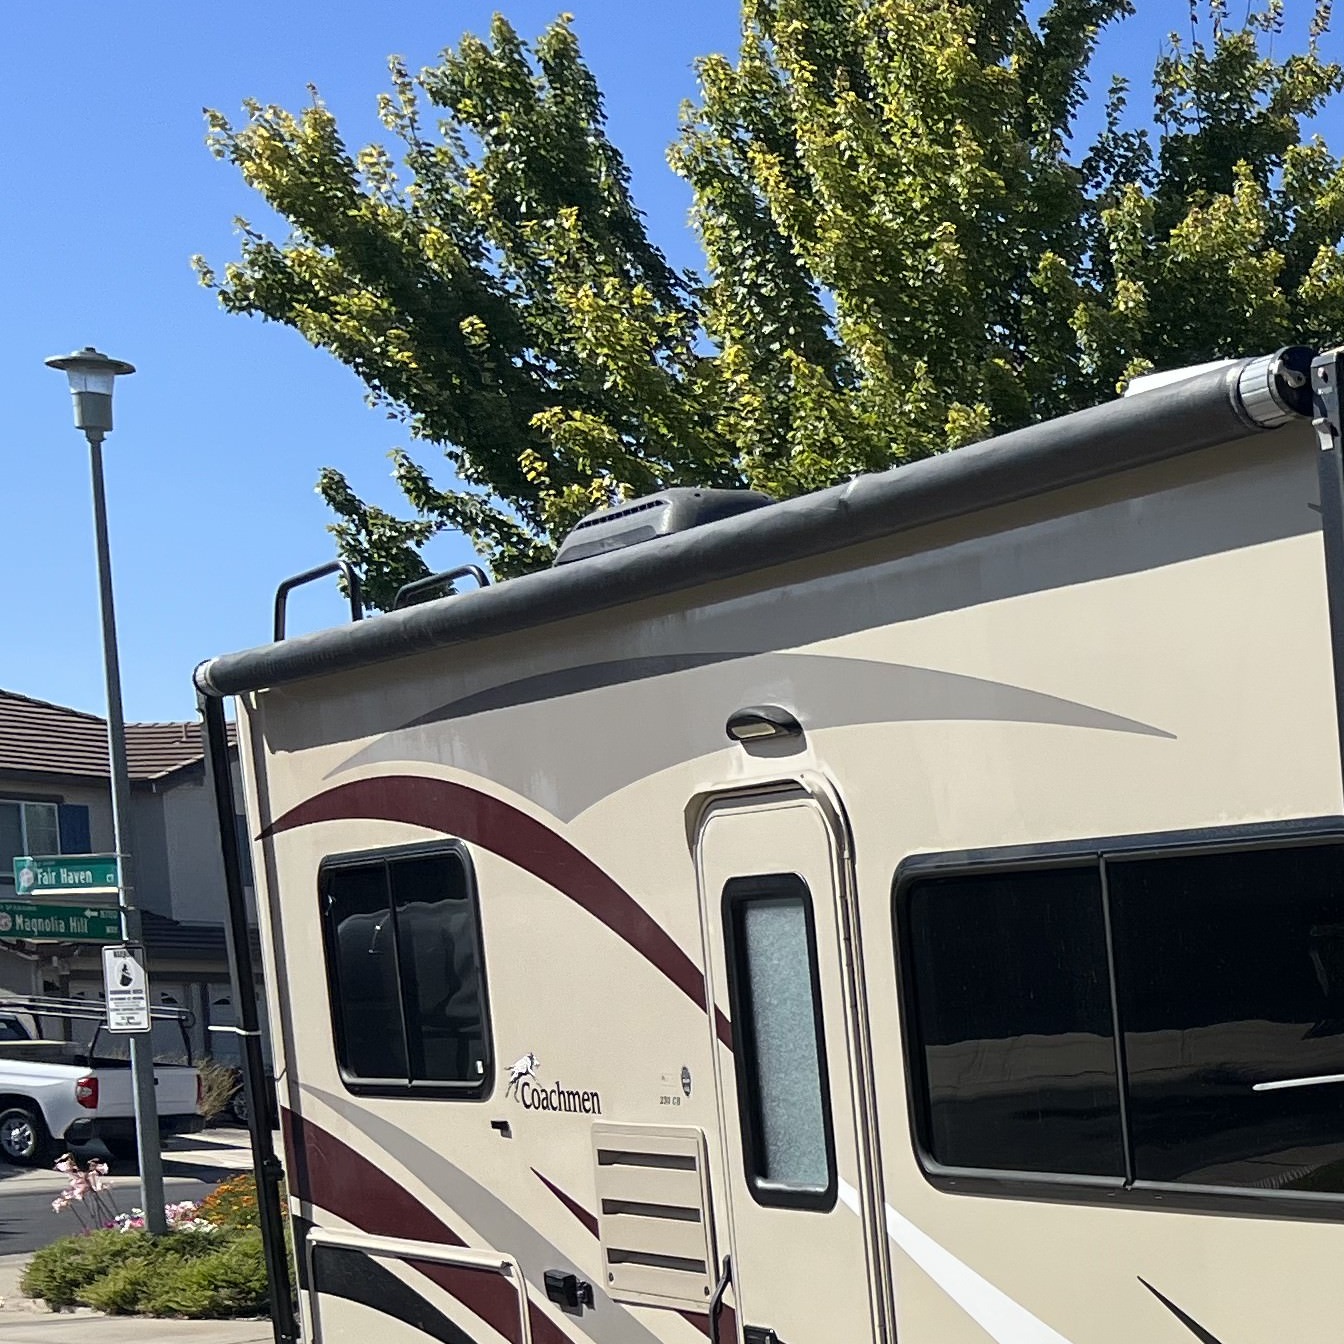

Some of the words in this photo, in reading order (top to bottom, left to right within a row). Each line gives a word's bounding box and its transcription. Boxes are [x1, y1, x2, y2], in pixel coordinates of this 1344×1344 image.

[37, 868, 56, 885] Fair
[60, 868, 93, 884] Haven
[15, 914, 65, 936] Magnolia
[69, 916, 88, 934] Hill
[521, 1081, 602, 1115] Coachmen
